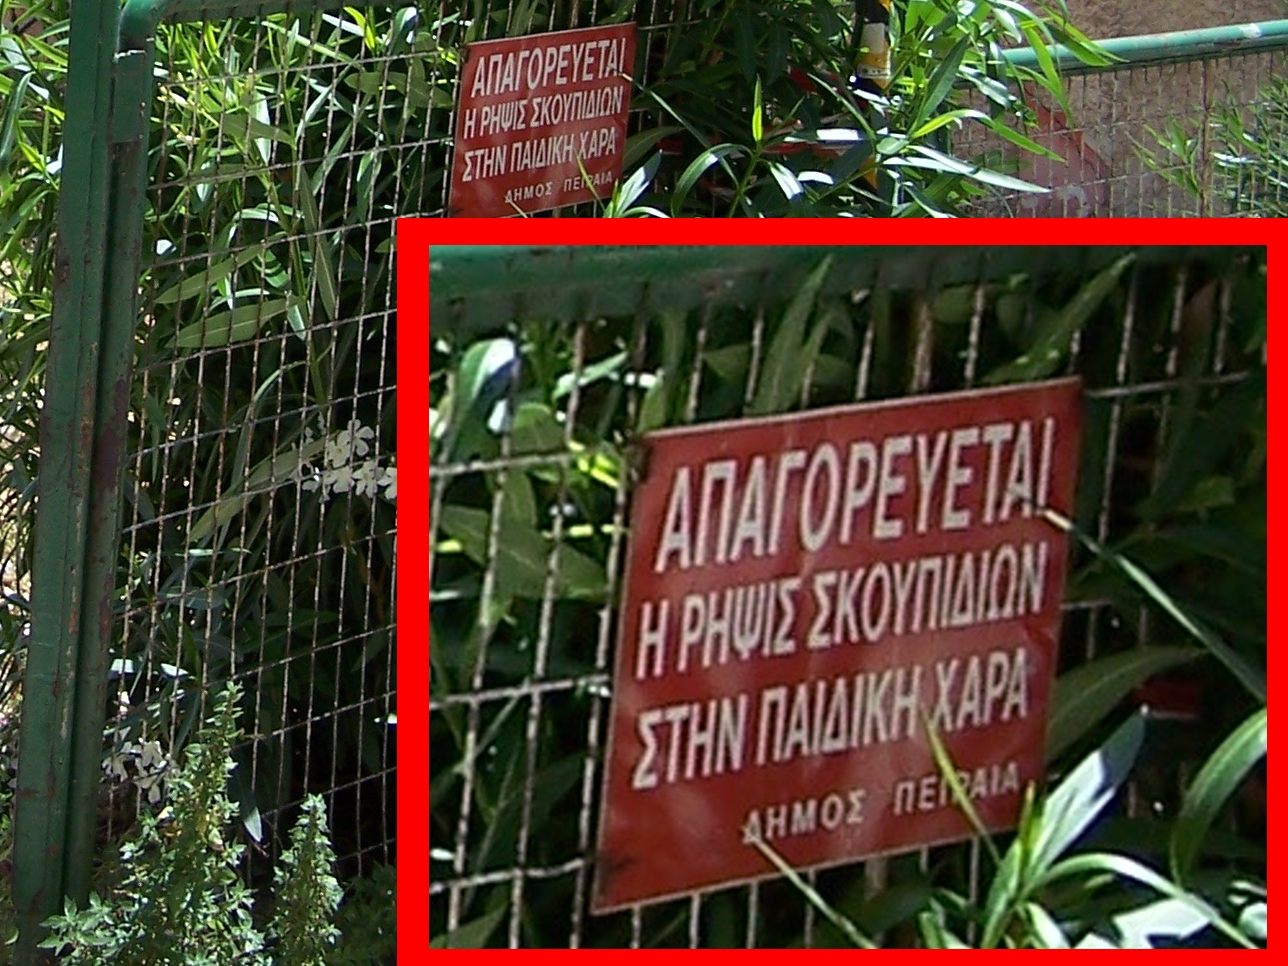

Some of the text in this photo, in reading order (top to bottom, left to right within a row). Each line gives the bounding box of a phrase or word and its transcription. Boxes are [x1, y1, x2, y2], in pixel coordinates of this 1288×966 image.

[471, 38, 627, 98] ΑΠΑΓΟΡΕΥΕΤΑΙ
[463, 86, 624, 139] Η ΡΗΨΙΣ ΣΚΟΥΠΙΔΙΩΝ
[462, 127, 616, 182] ΣΤΗΝ ΠΑΙΔΙΚΗ ΧΑΡΑ
[506, 182, 553, 203] ΔΗΜΟΣ
